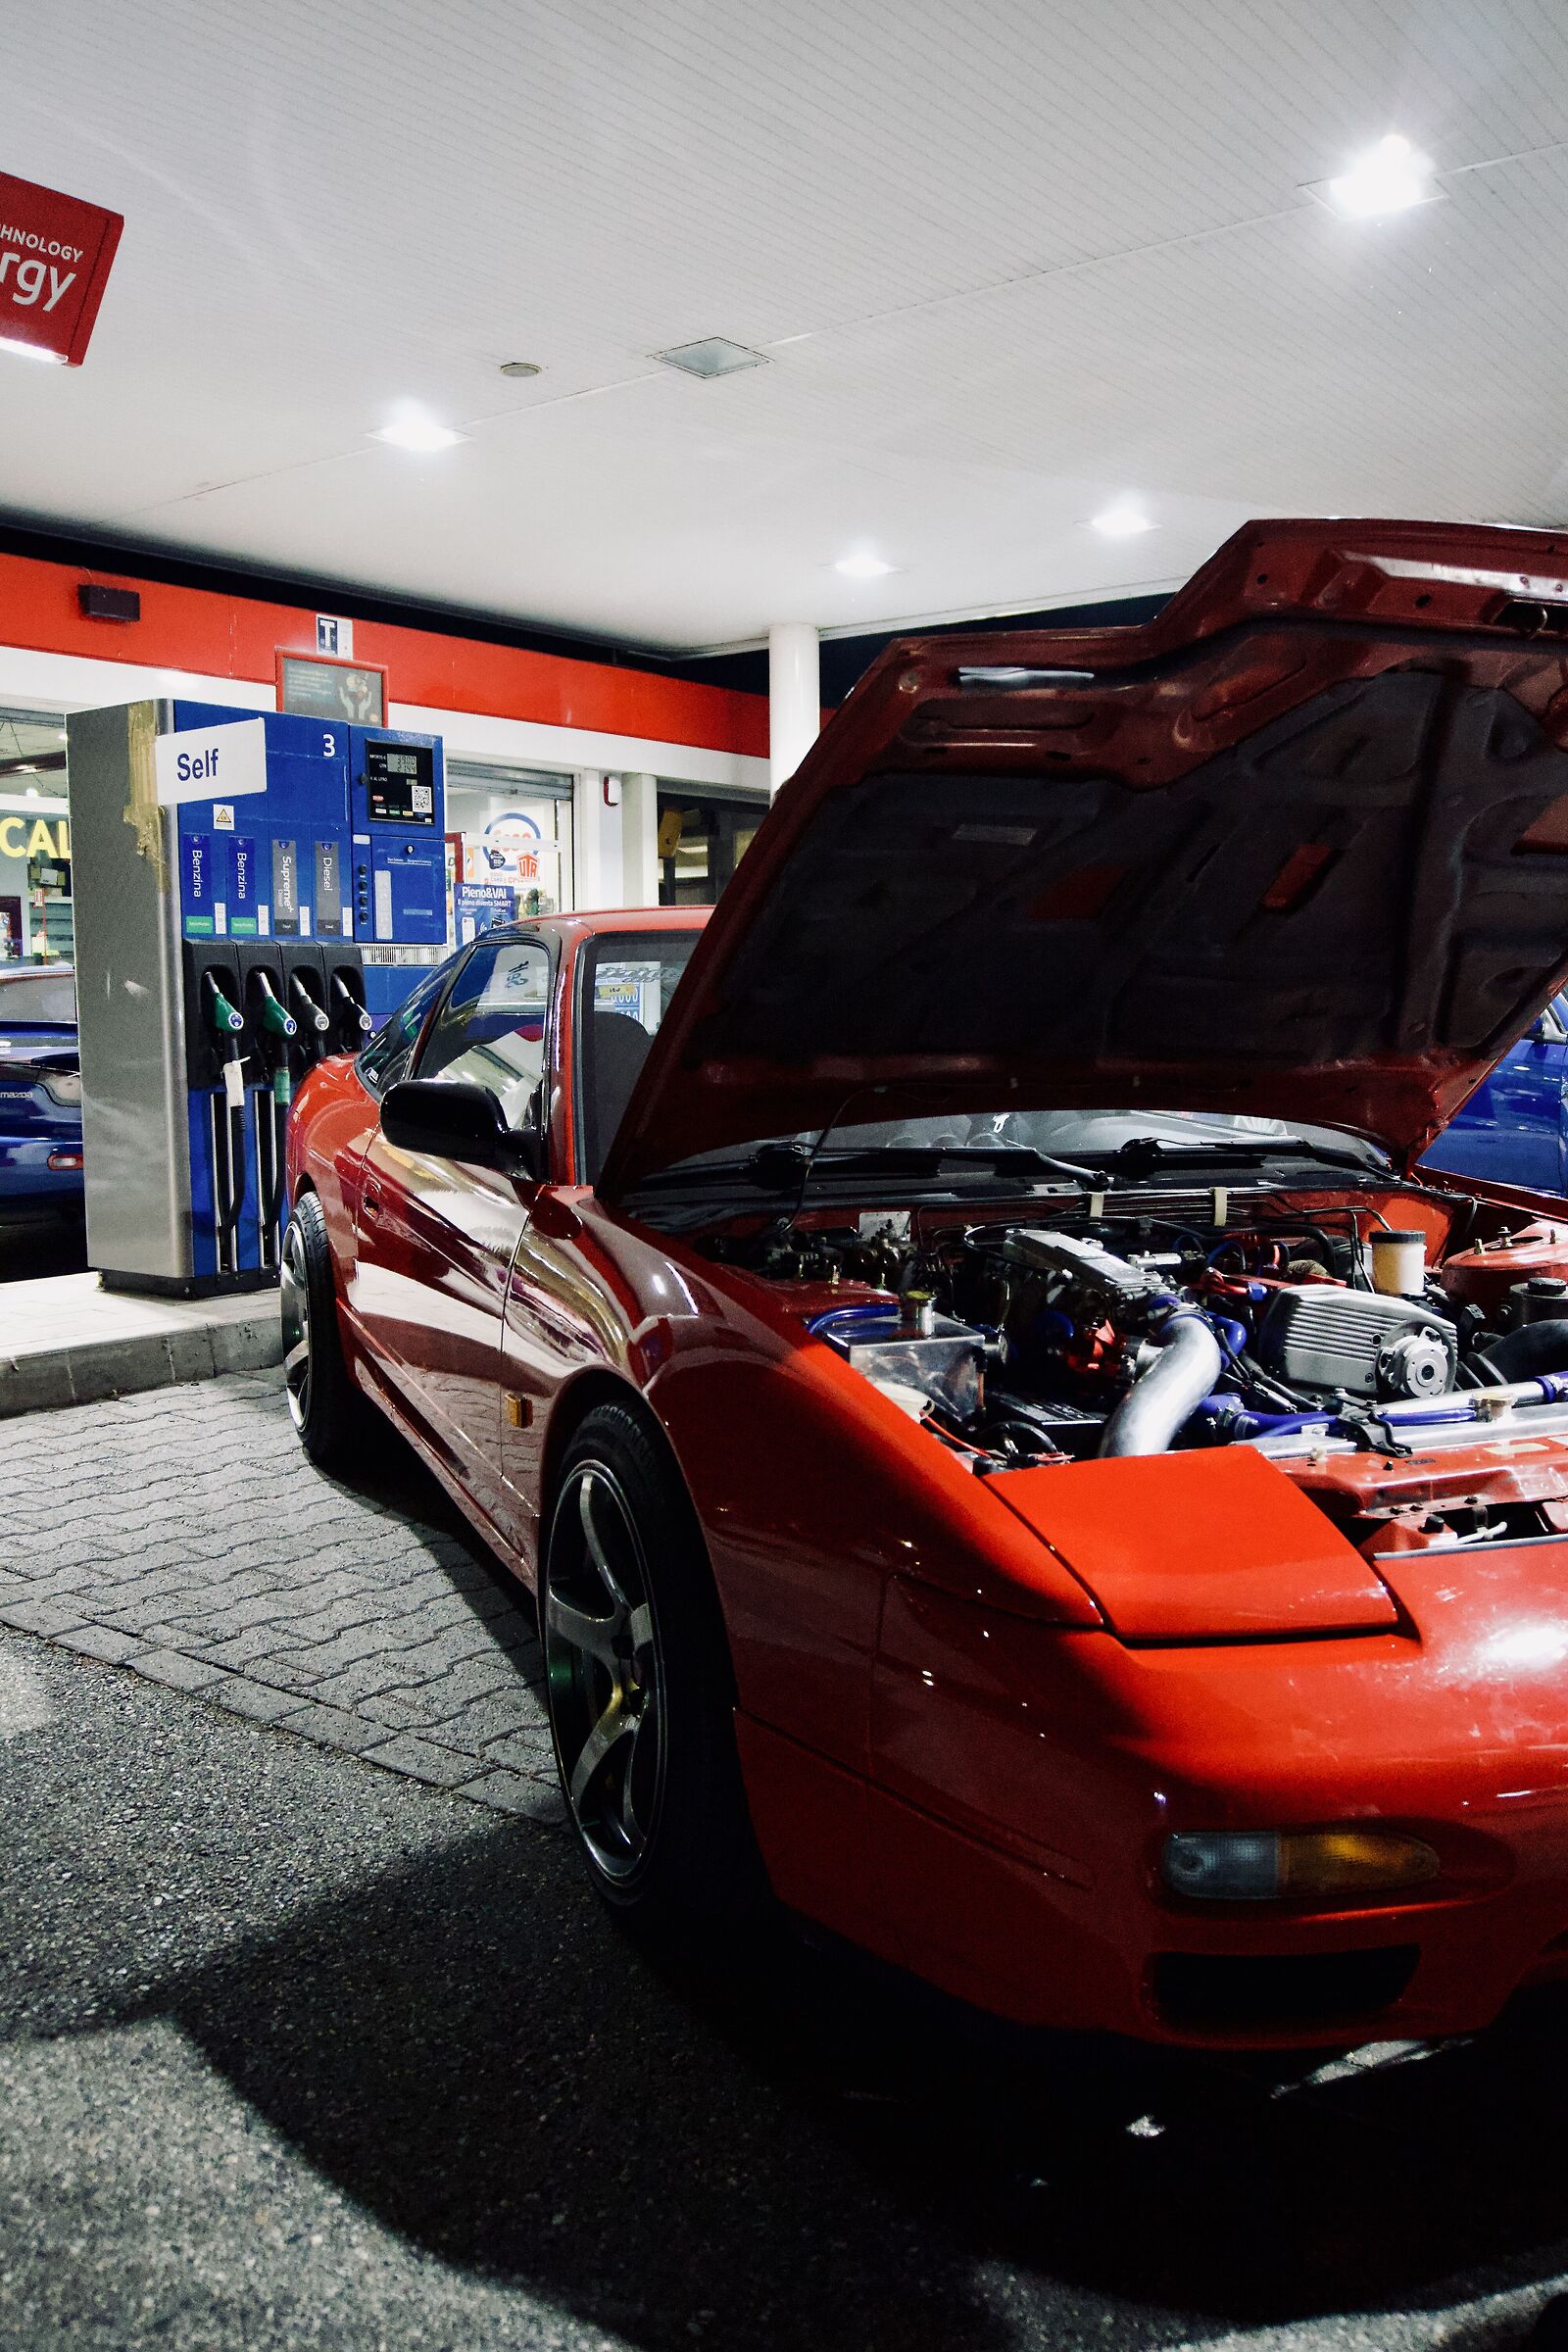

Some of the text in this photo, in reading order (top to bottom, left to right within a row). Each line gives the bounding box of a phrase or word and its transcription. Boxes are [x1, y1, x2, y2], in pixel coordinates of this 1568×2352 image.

[0, 224, 84, 264] HNOLOGY
[322, 734, 335, 758] 3
[176, 748, 219, 781] Self
[192, 850, 203, 898] Benzina
[237, 853, 247, 899] Benzina
[322, 858, 333, 891] Diesel
[462, 886, 507, 900] Pieno&VAI
